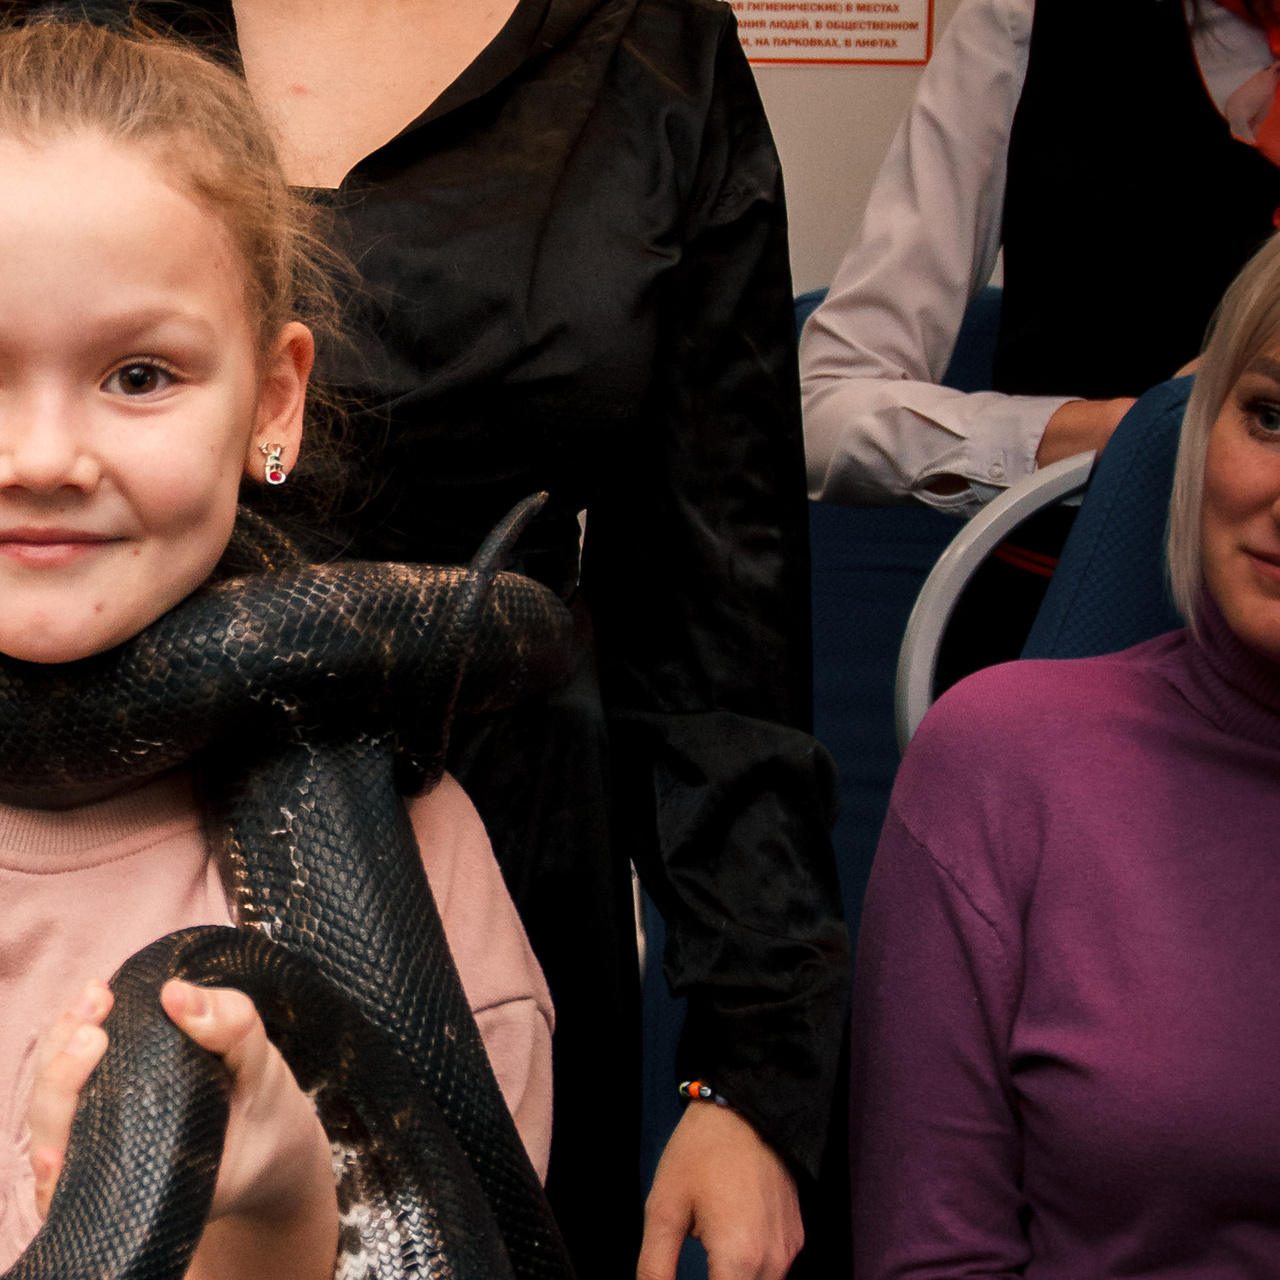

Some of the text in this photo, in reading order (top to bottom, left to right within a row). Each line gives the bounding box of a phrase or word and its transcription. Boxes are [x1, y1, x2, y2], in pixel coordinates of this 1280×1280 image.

[845, 3, 853, 12] В
[856, 3, 900, 13] МЕСТАХ
[815, 20, 822, 29] В
[825, 20, 919, 31] ОБЩЕСТВЕННОМ
[755, 37, 770, 47] НА
[773, 37, 841, 48] ПАРКОВКАХ,
[844, 38, 852, 47] В
[855, 38, 898, 48] ЛИФТАХ
